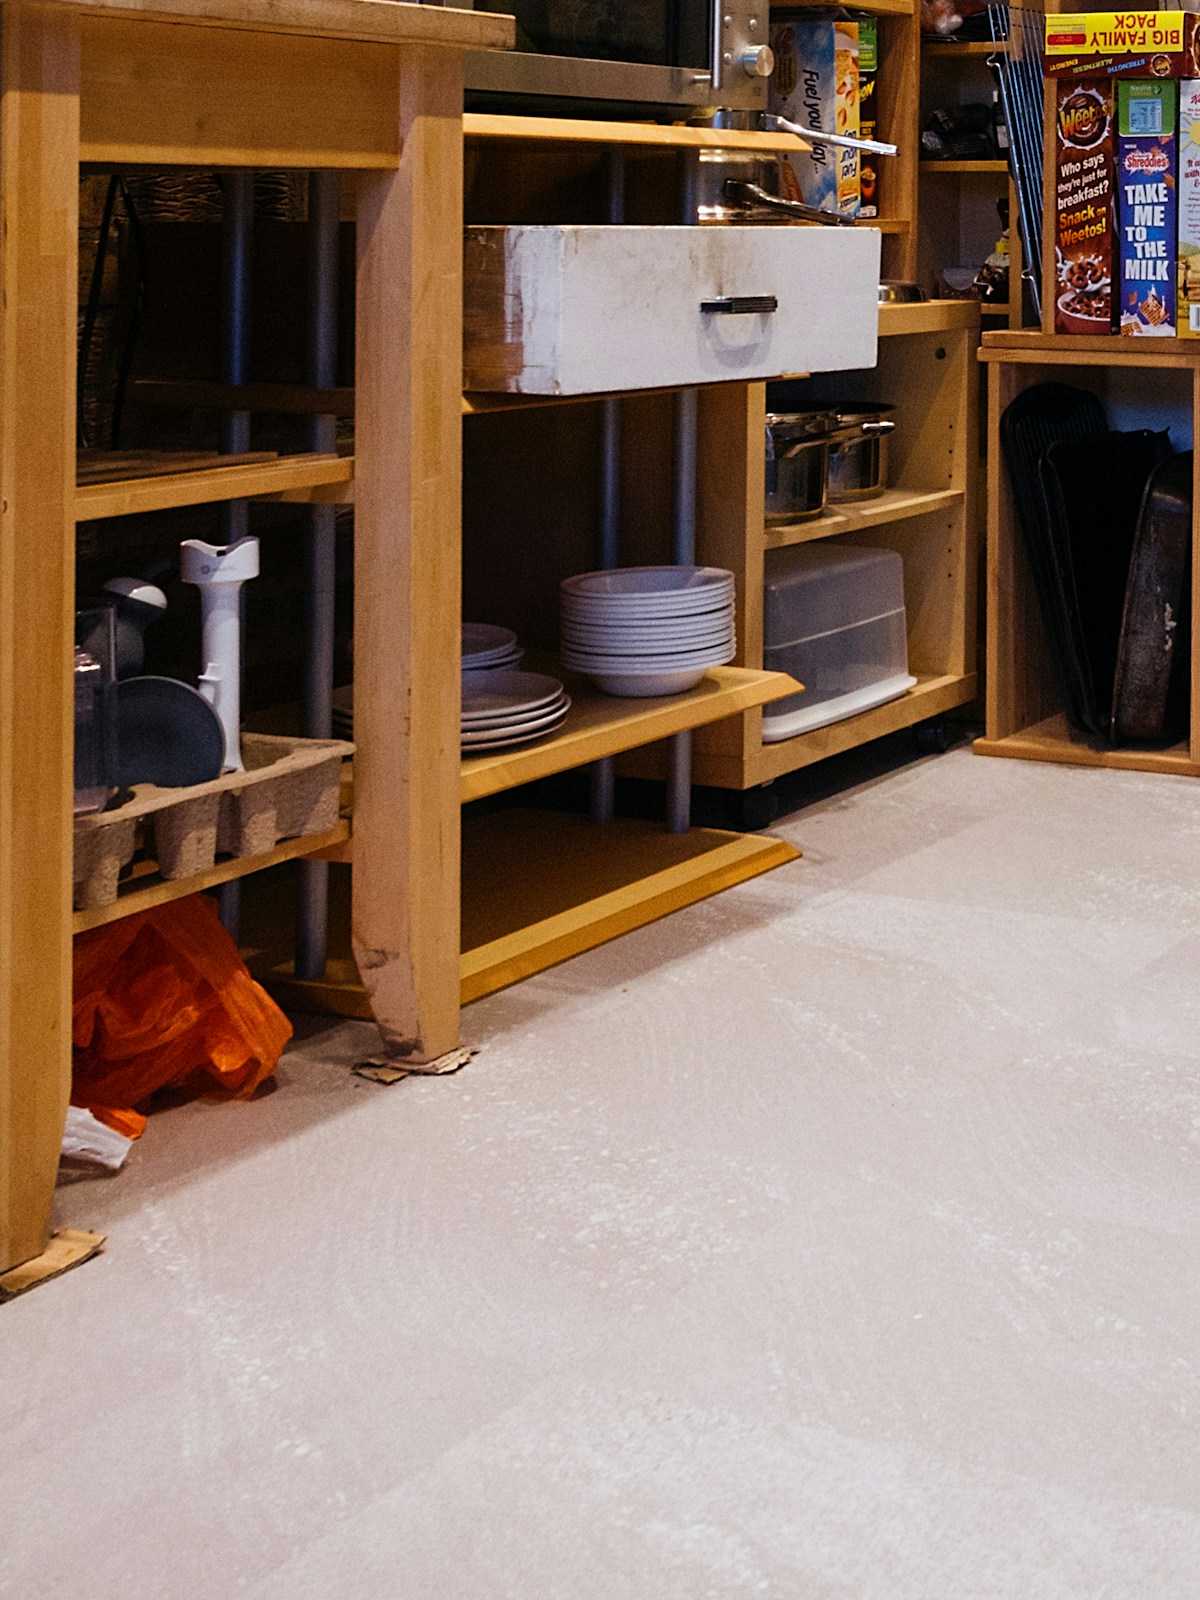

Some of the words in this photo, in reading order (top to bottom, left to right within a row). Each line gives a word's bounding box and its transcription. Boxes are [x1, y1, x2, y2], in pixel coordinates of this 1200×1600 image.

[1114, 14, 1156, 29] PACK
[1090, 30, 1146, 46] FAMILY
[1153, 30, 1180, 44] BIG
[803, 69, 822, 100] Fuel
[803, 101, 822, 129] you
[1060, 104, 1108, 138] Weetos
[1061, 162, 1081, 177] Who
[1083, 153, 1105, 169] says
[1127, 155, 1167, 168] Shreddies
[1058, 179, 1081, 193] they're
[1081, 172, 1096, 187] just
[1097, 168, 1107, 179] for
[1184, 169, 1200, 179] with
[1194, 178, 1200, 188] &
[1058, 180, 1109, 210] breakfast?
[1124, 182, 1168, 205] TAKE
[1060, 204, 1095, 229] Snack
[1096, 206, 1107, 216] on
[1134, 205, 1165, 227] ME
[1060, 217, 1107, 247] Weetos!
[1125, 226, 1147, 242] TO
[1134, 241, 1167, 259] THE
[1125, 259, 1169, 281] MILK
